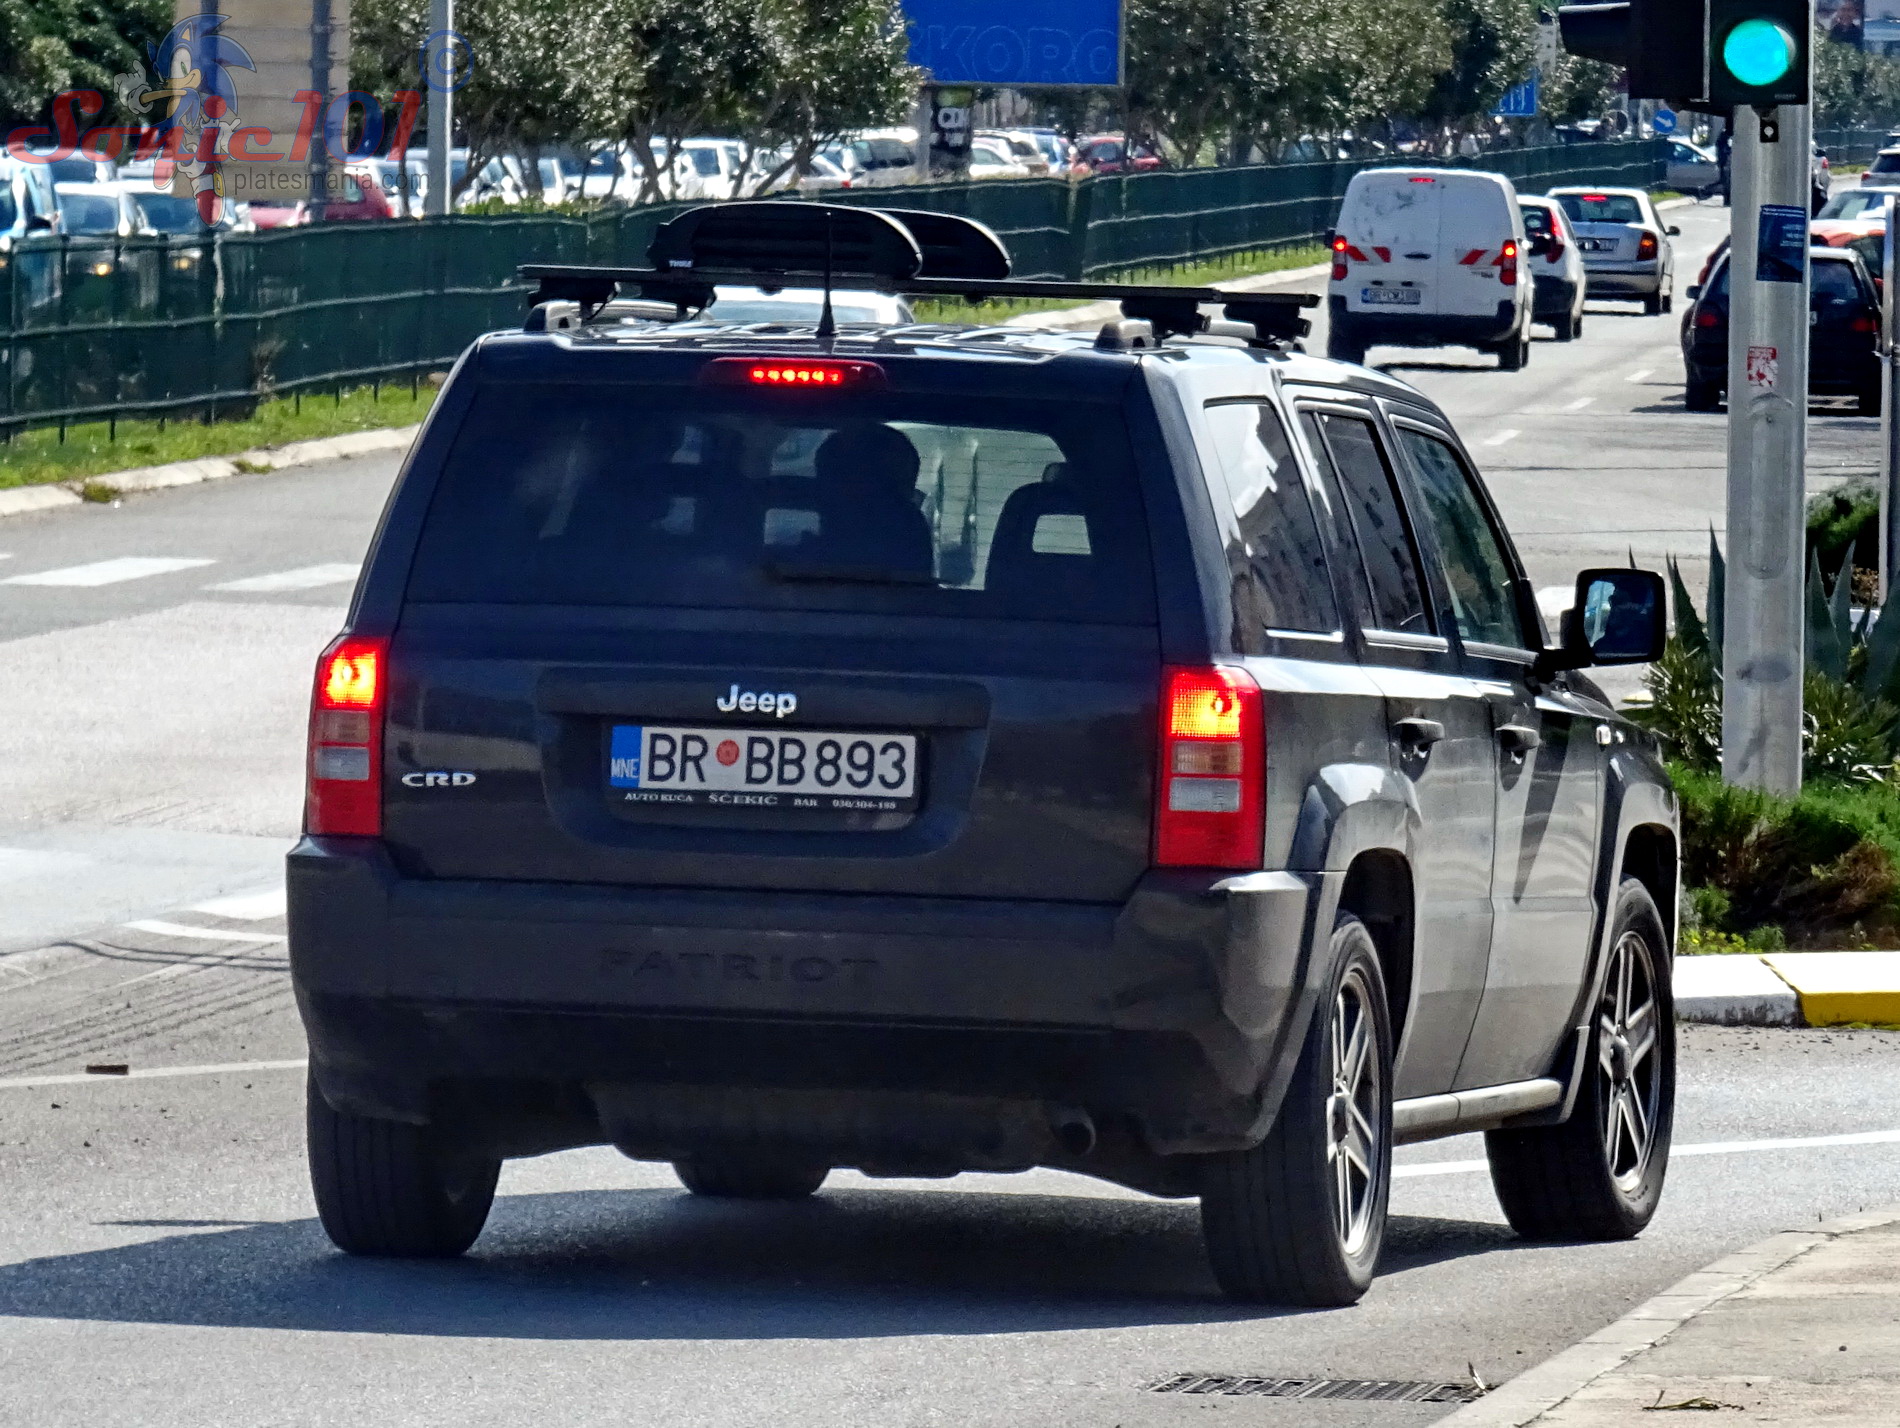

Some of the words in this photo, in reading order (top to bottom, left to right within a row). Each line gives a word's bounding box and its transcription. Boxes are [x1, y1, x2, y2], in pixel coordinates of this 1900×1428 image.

[716, 684, 798, 719] Jeep
[611, 757, 639, 779] MNE
[647, 732, 709, 783] BR
[401, 771, 477, 787] CRD
[625, 791, 658, 802] AUTO
[793, 798, 818, 808] BAR
[598, 948, 880, 986] PATRIOT
